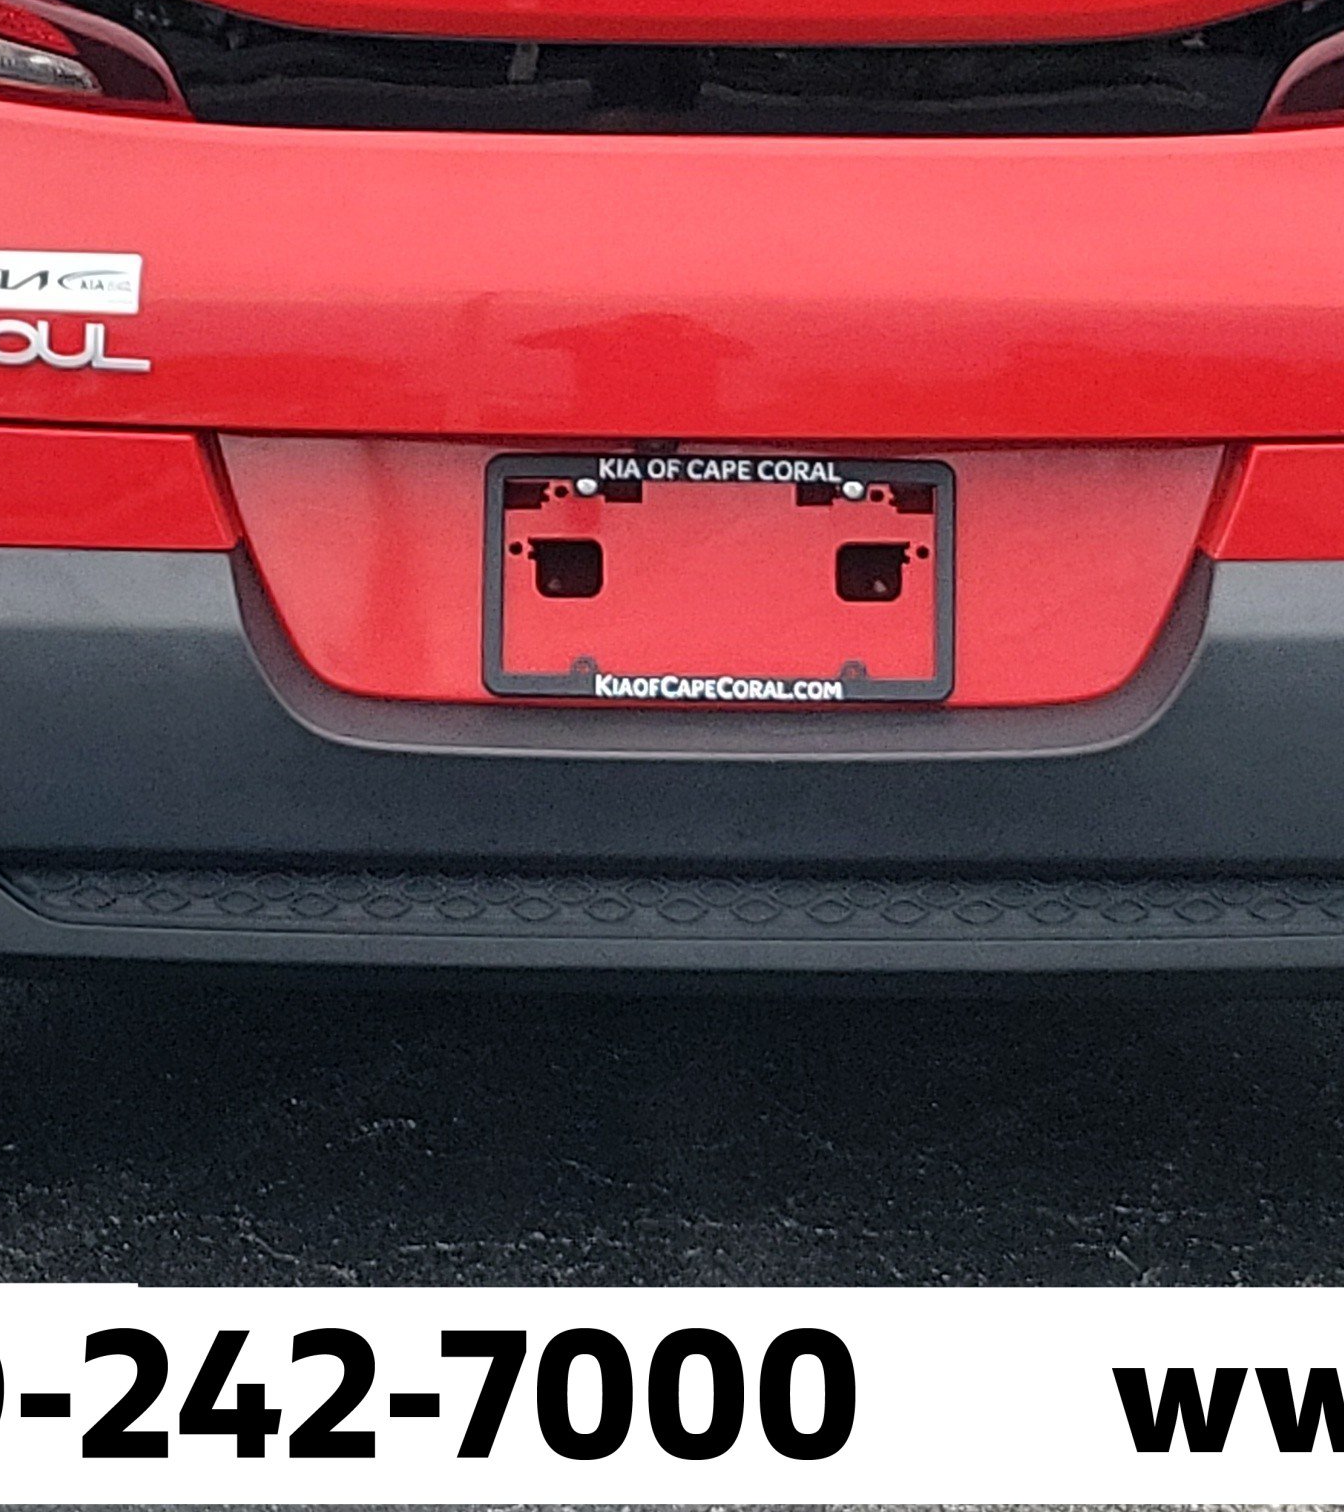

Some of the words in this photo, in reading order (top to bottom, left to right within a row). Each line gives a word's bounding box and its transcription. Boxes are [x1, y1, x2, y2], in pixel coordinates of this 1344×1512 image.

[598, 458, 642, 479] KIA
[647, 458, 680, 479] OF
[687, 458, 751, 480] CAPE
[757, 459, 841, 481] CORAL
